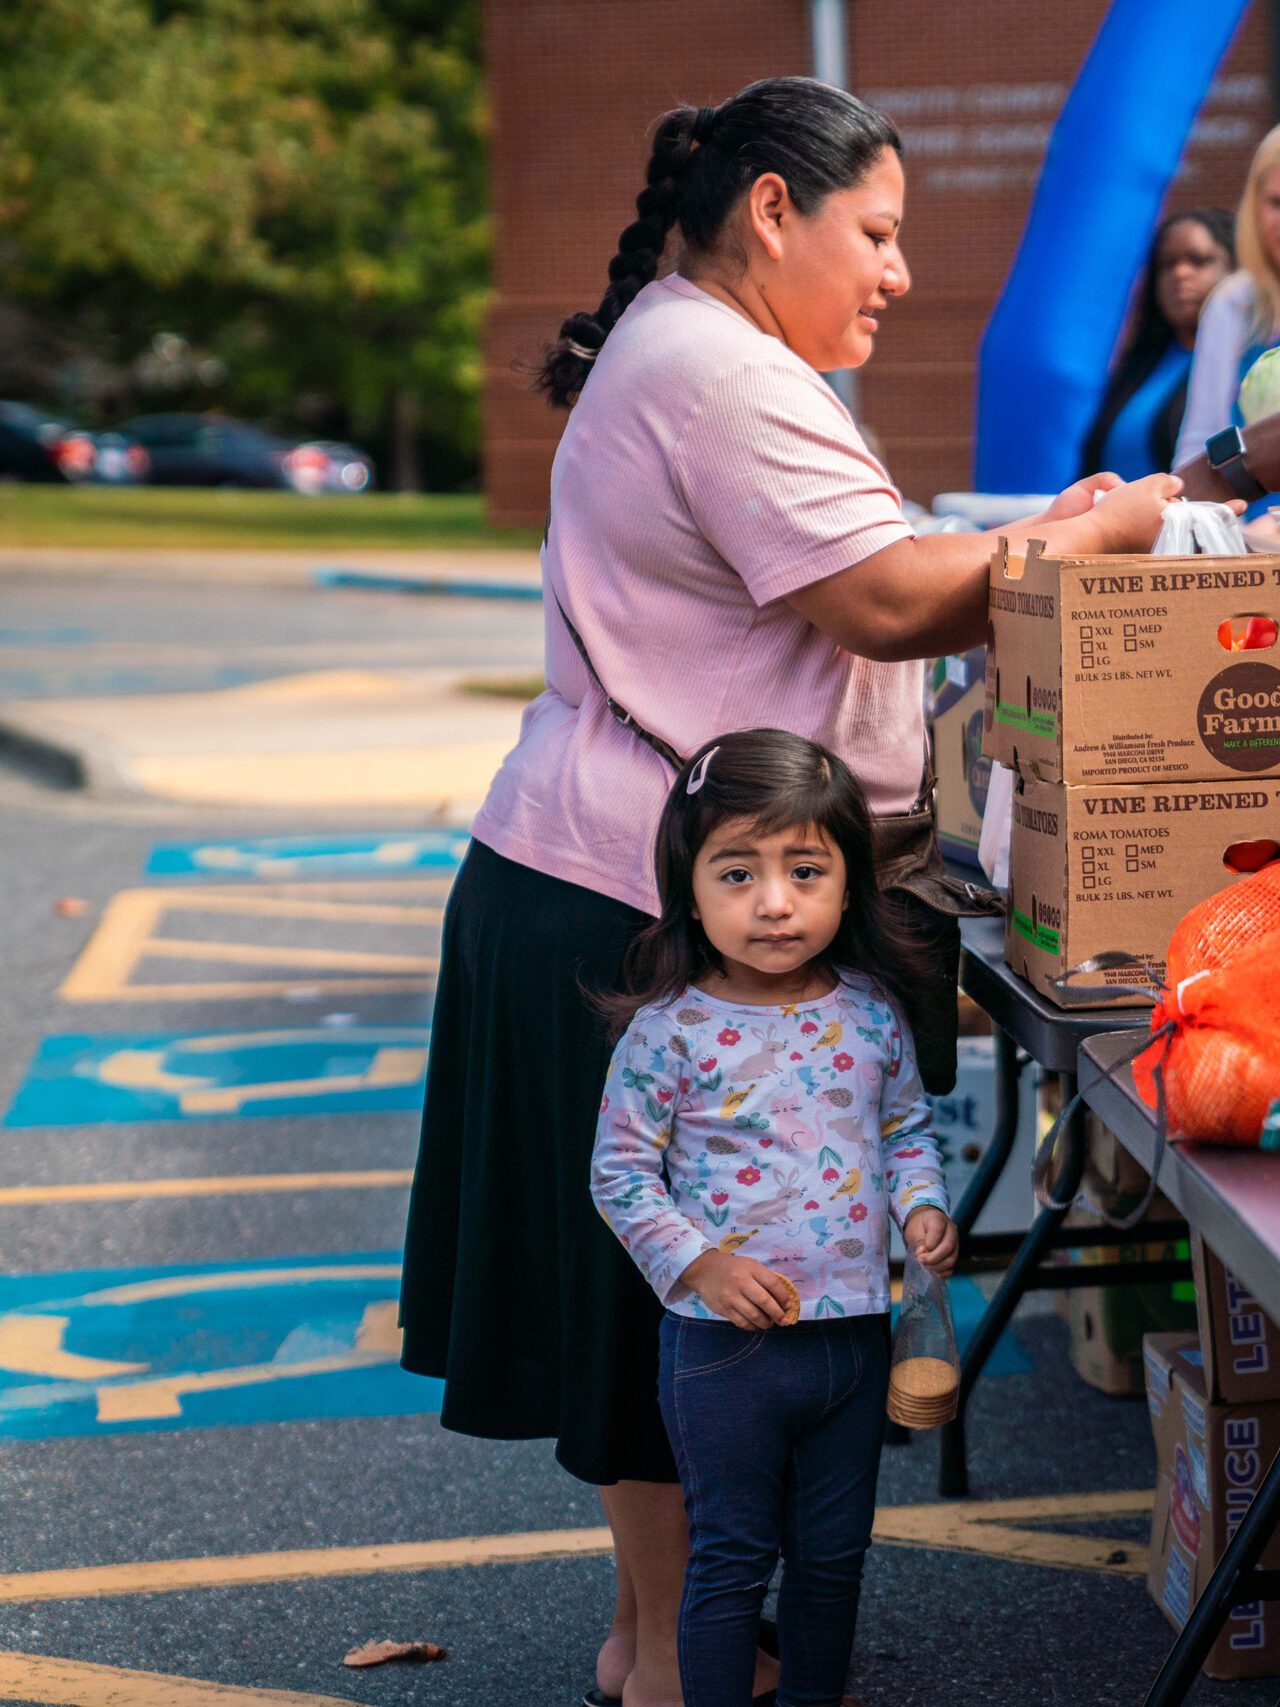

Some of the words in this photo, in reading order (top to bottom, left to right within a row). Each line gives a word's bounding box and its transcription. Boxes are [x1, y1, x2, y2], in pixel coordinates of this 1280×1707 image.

[1079, 576, 1143, 595] VINE
[1151, 570, 1265, 592] RIPENED
[1017, 592, 1054, 619] TOMATOES
[1071, 610, 1106, 621] ROMA
[1108, 607, 1168, 619] TOMATOES
[1095, 627, 1114, 636] XXL
[1138, 624, 1162, 634] MED
[1096, 642, 1108, 650] XL
[1139, 640, 1155, 648] SM
[1096, 656, 1111, 666] LG
[1074, 673, 1099, 682] BULK
[1101, 672, 1112, 681] 25
[1115, 671, 1133, 680] LBS.
[1136, 670, 1155, 680] NET
[1156, 669, 1173, 678] WT.
[1144, 733, 1153, 741] by:
[1073, 744, 1099, 753] Andrew
[1108, 741, 1146, 751] Williamson
[1146, 740, 1166, 748] Fresh
[1166, 739, 1195, 748] Produce
[1222, 738, 1242, 749] MAKE
[1146, 748, 1165, 756] DRIVE
[1117, 757, 1138, 765] DIEGO,
[1081, 766, 1117, 776] IMPORTED
[1118, 765, 1151, 774] PRODUCT
[1152, 764, 1162, 772] OF
[1162, 763, 1189, 772] MEXICO
[1082, 796, 1146, 815] VINE
[1152, 790, 1269, 813] RIPENED
[1020, 808, 1058, 836] TOMATOES
[1072, 830, 1109, 841] ROMA
[1110, 827, 1170, 840] TOMATOES
[1096, 846, 1116, 857] XXL
[1140, 844, 1164, 855] MED
[1097, 862, 1110, 872] XL
[1140, 860, 1157, 870] SM
[1097, 876, 1113, 887] LG
[1075, 893, 1100, 902] BULK
[1102, 892, 1114, 901] 25
[1116, 891, 1135, 901] LBS.
[1137, 890, 1157, 900] NET
[1158, 889, 1175, 899] WT.
[1118, 977, 1139, 985] DIEGO,
